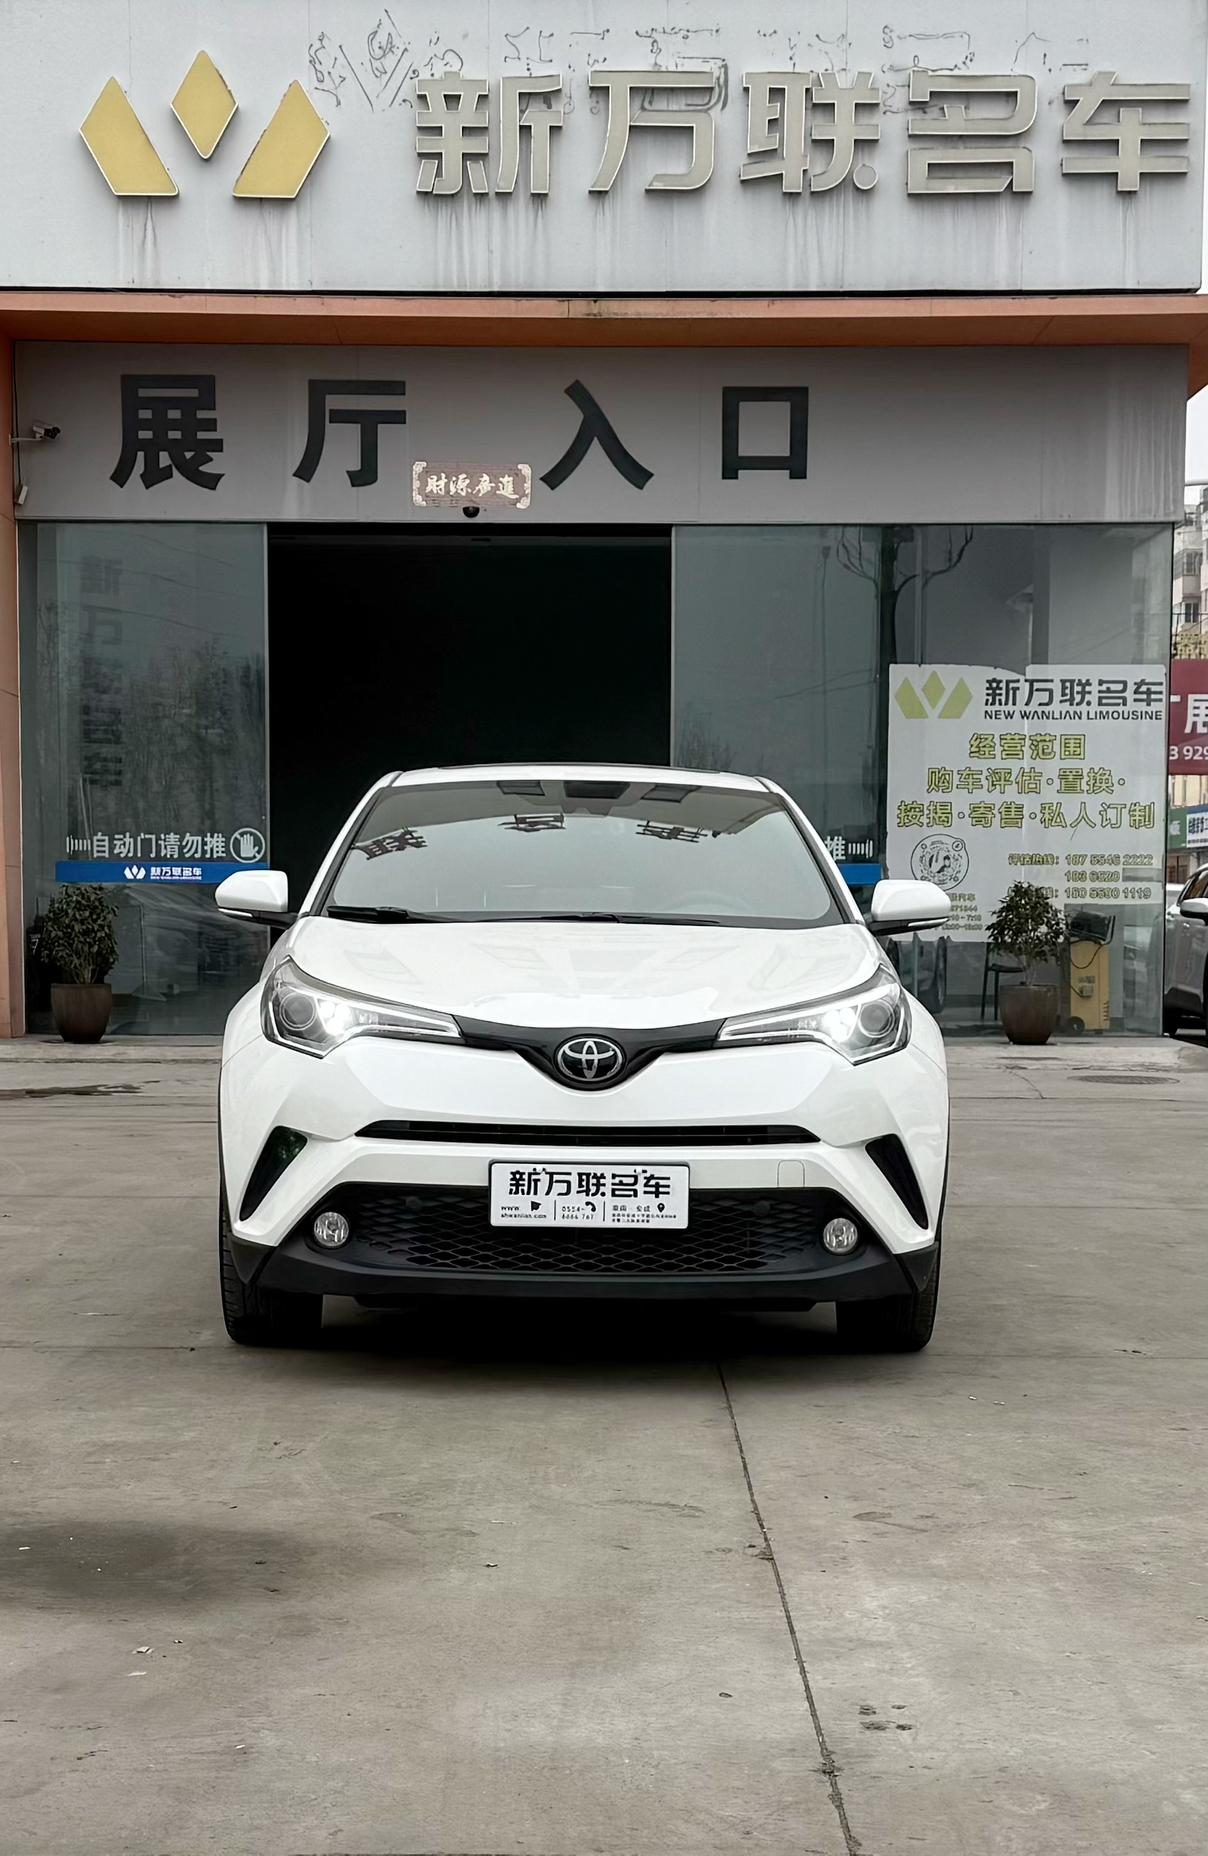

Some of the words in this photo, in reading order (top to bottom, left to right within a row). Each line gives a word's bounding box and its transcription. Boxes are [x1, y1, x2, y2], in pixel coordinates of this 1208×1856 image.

[414, 70, 1191, 195] 新万联名车
[109, 374, 809, 490] 展厅入口
[984, 677, 1163, 706] 新万联名车
[984, 710, 1015, 720] NEW
[1019, 710, 1082, 720] WANLIAN
[1087, 710, 1162, 720] LIMOUSINE
[968, 733, 1086, 760] 经营范围
[92, 832, 227, 859] 自动门请勿推
[508, 1169, 671, 1198] 新万联名车
